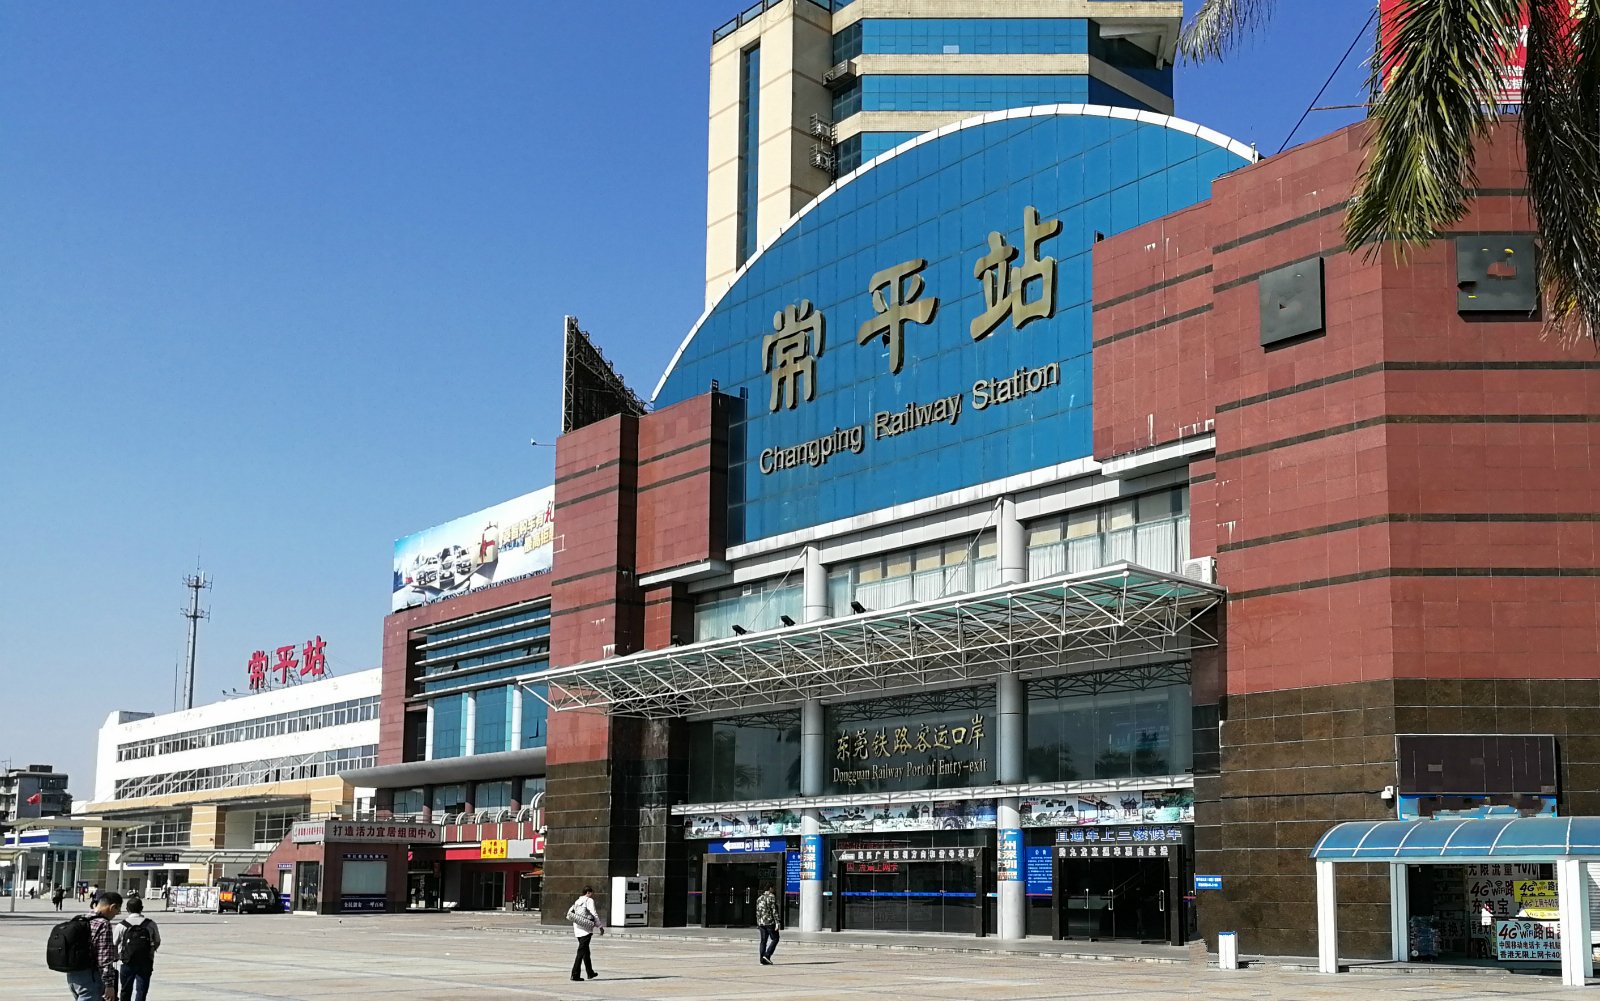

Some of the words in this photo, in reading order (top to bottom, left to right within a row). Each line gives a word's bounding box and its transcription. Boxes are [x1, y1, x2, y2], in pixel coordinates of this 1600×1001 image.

[762, 205, 1064, 412] 常平站
[759, 424, 864, 475] Changping
[874, 391, 963, 439] Railway
[971, 361, 1061, 411] Station
[248, 635, 328, 690] 常平站
[836, 713, 986, 762] 东莞铁路客运口岸
[833, 767, 871, 786] Dongguan
[872, 763, 904, 782] Railway
[906, 761, 925, 777] Port
[926, 759, 937, 775] of
[333, 825, 437, 838] 打造活力宜居组团中心
[1498, 923, 1517, 940] 4G
